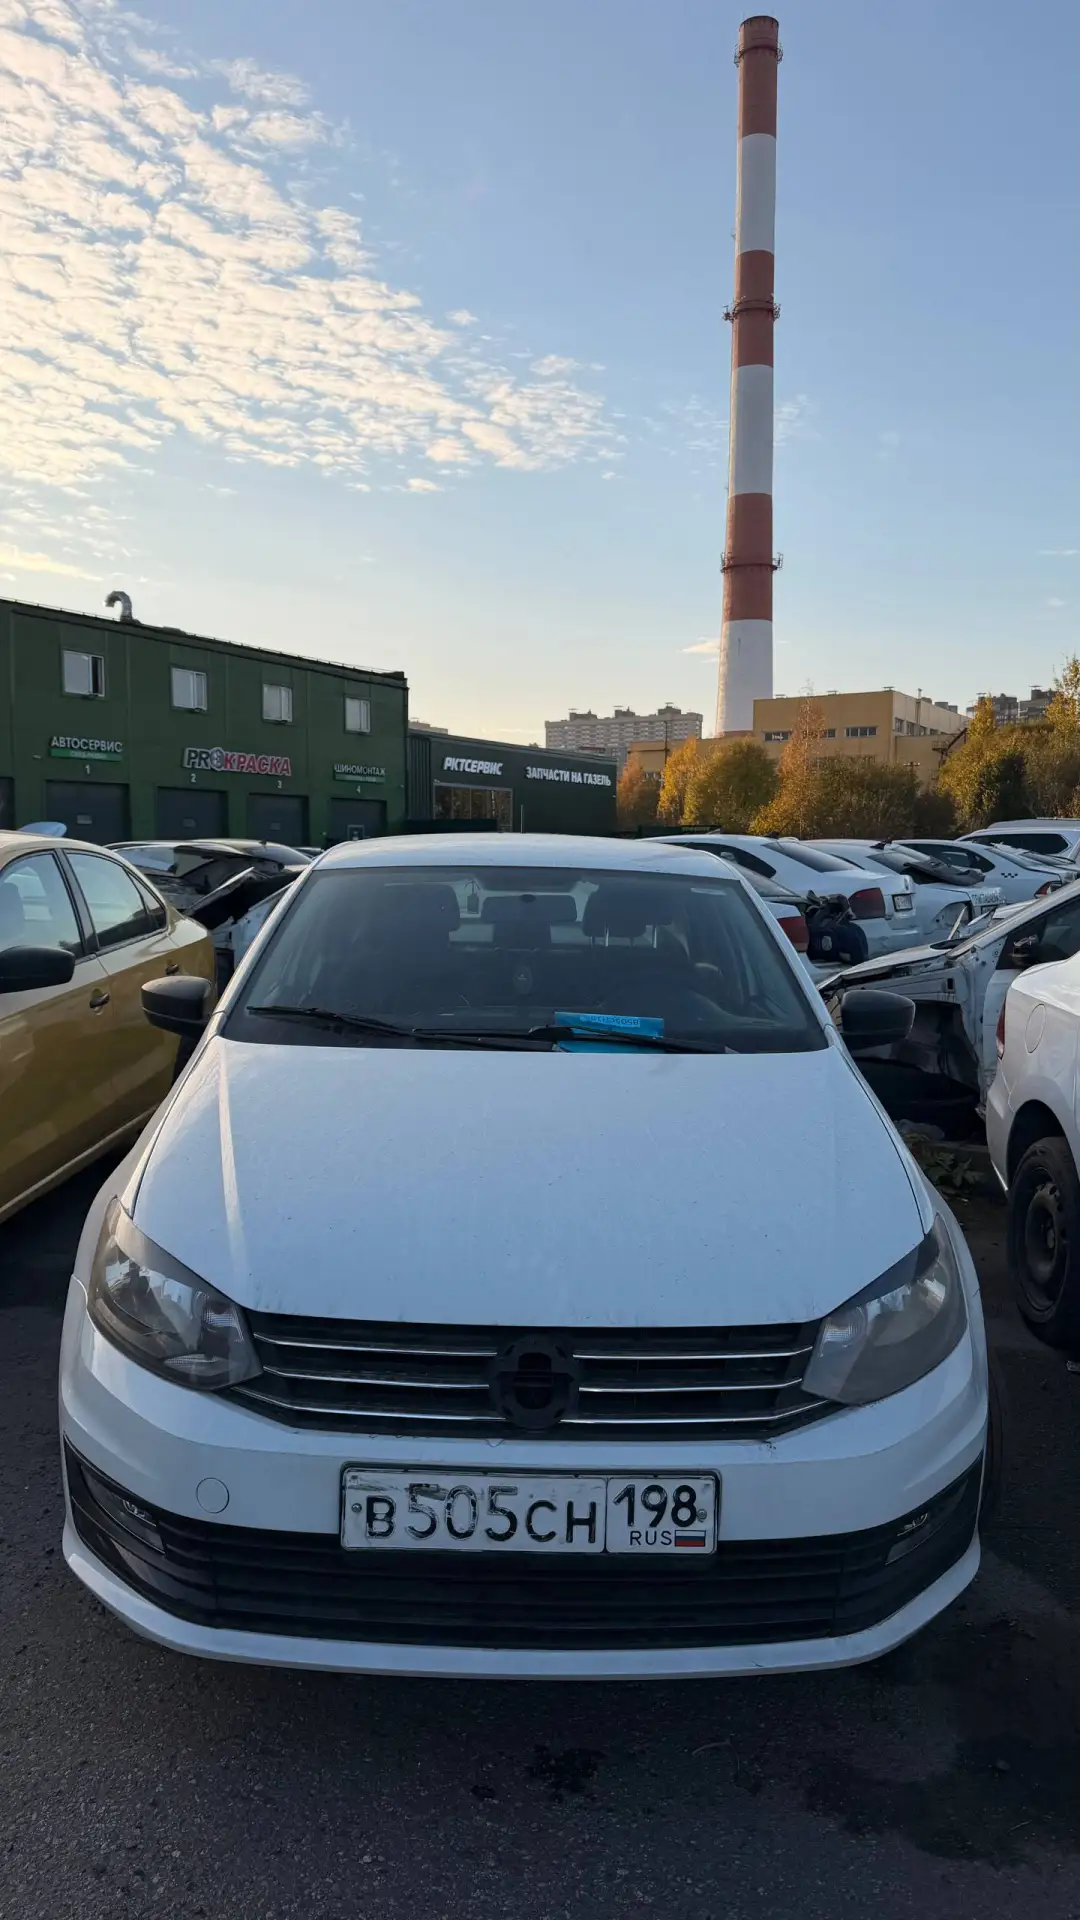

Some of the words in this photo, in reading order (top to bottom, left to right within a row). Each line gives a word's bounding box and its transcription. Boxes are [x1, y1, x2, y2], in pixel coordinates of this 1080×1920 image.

[51, 735, 123, 753] АВТОСЕРВИС
[85, 764, 91, 774] 1
[334, 763, 386, 776] ШИНОМОНТАЖ
[190, 773, 197, 783] 2
[525, 766, 570, 783] ЗАПЧАСТИ
[571, 771, 583, 784] НА
[583, 773, 612, 787] ГАЗЕЛЬ
[277, 780, 283, 789] 3
[356, 784, 361, 794] 4
[613, 1484, 697, 1527] 198
[629, 1530, 673, 1546] RUS
